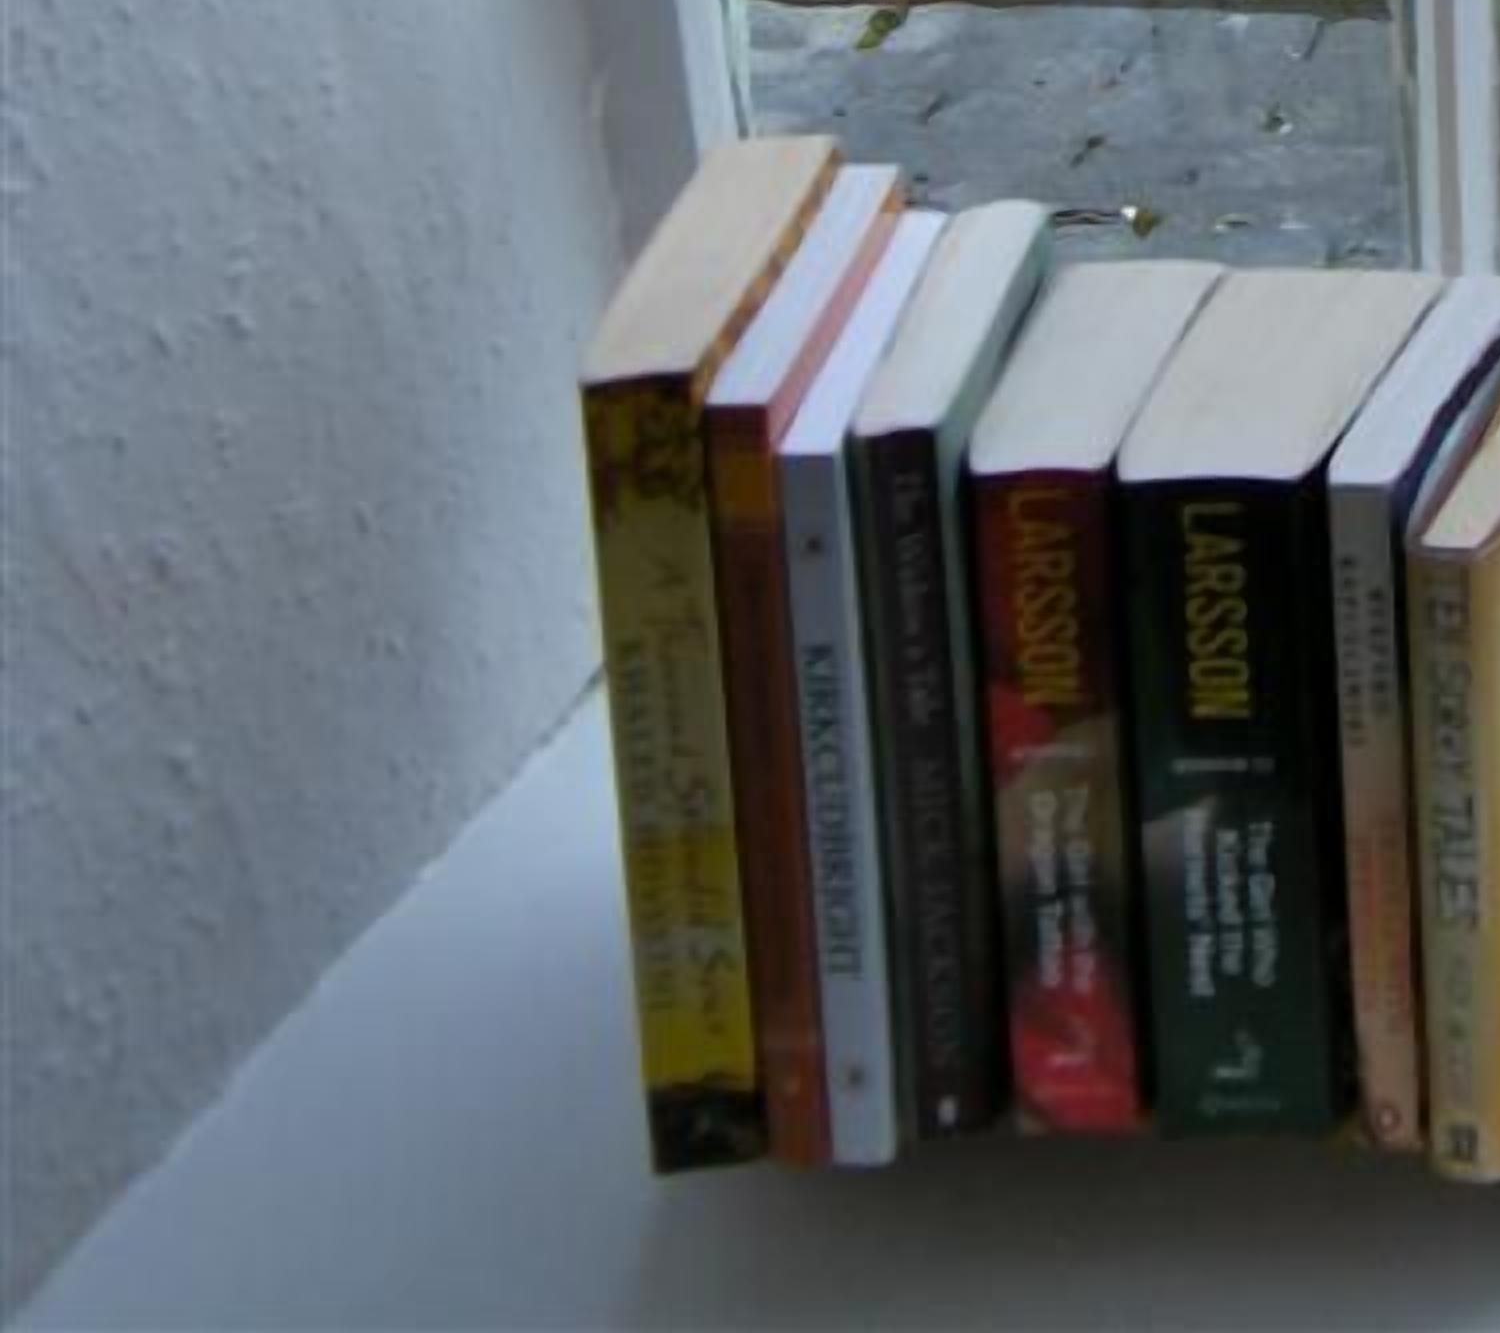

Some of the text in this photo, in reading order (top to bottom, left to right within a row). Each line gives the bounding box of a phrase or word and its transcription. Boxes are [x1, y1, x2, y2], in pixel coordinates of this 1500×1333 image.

[1009, 487, 1082, 706] LARSSON
[1183, 501, 1251, 720] LARSSON
[799, 643, 864, 982] KIRKCUDBRIGHT
[1431, 795, 1481, 938] TALES
